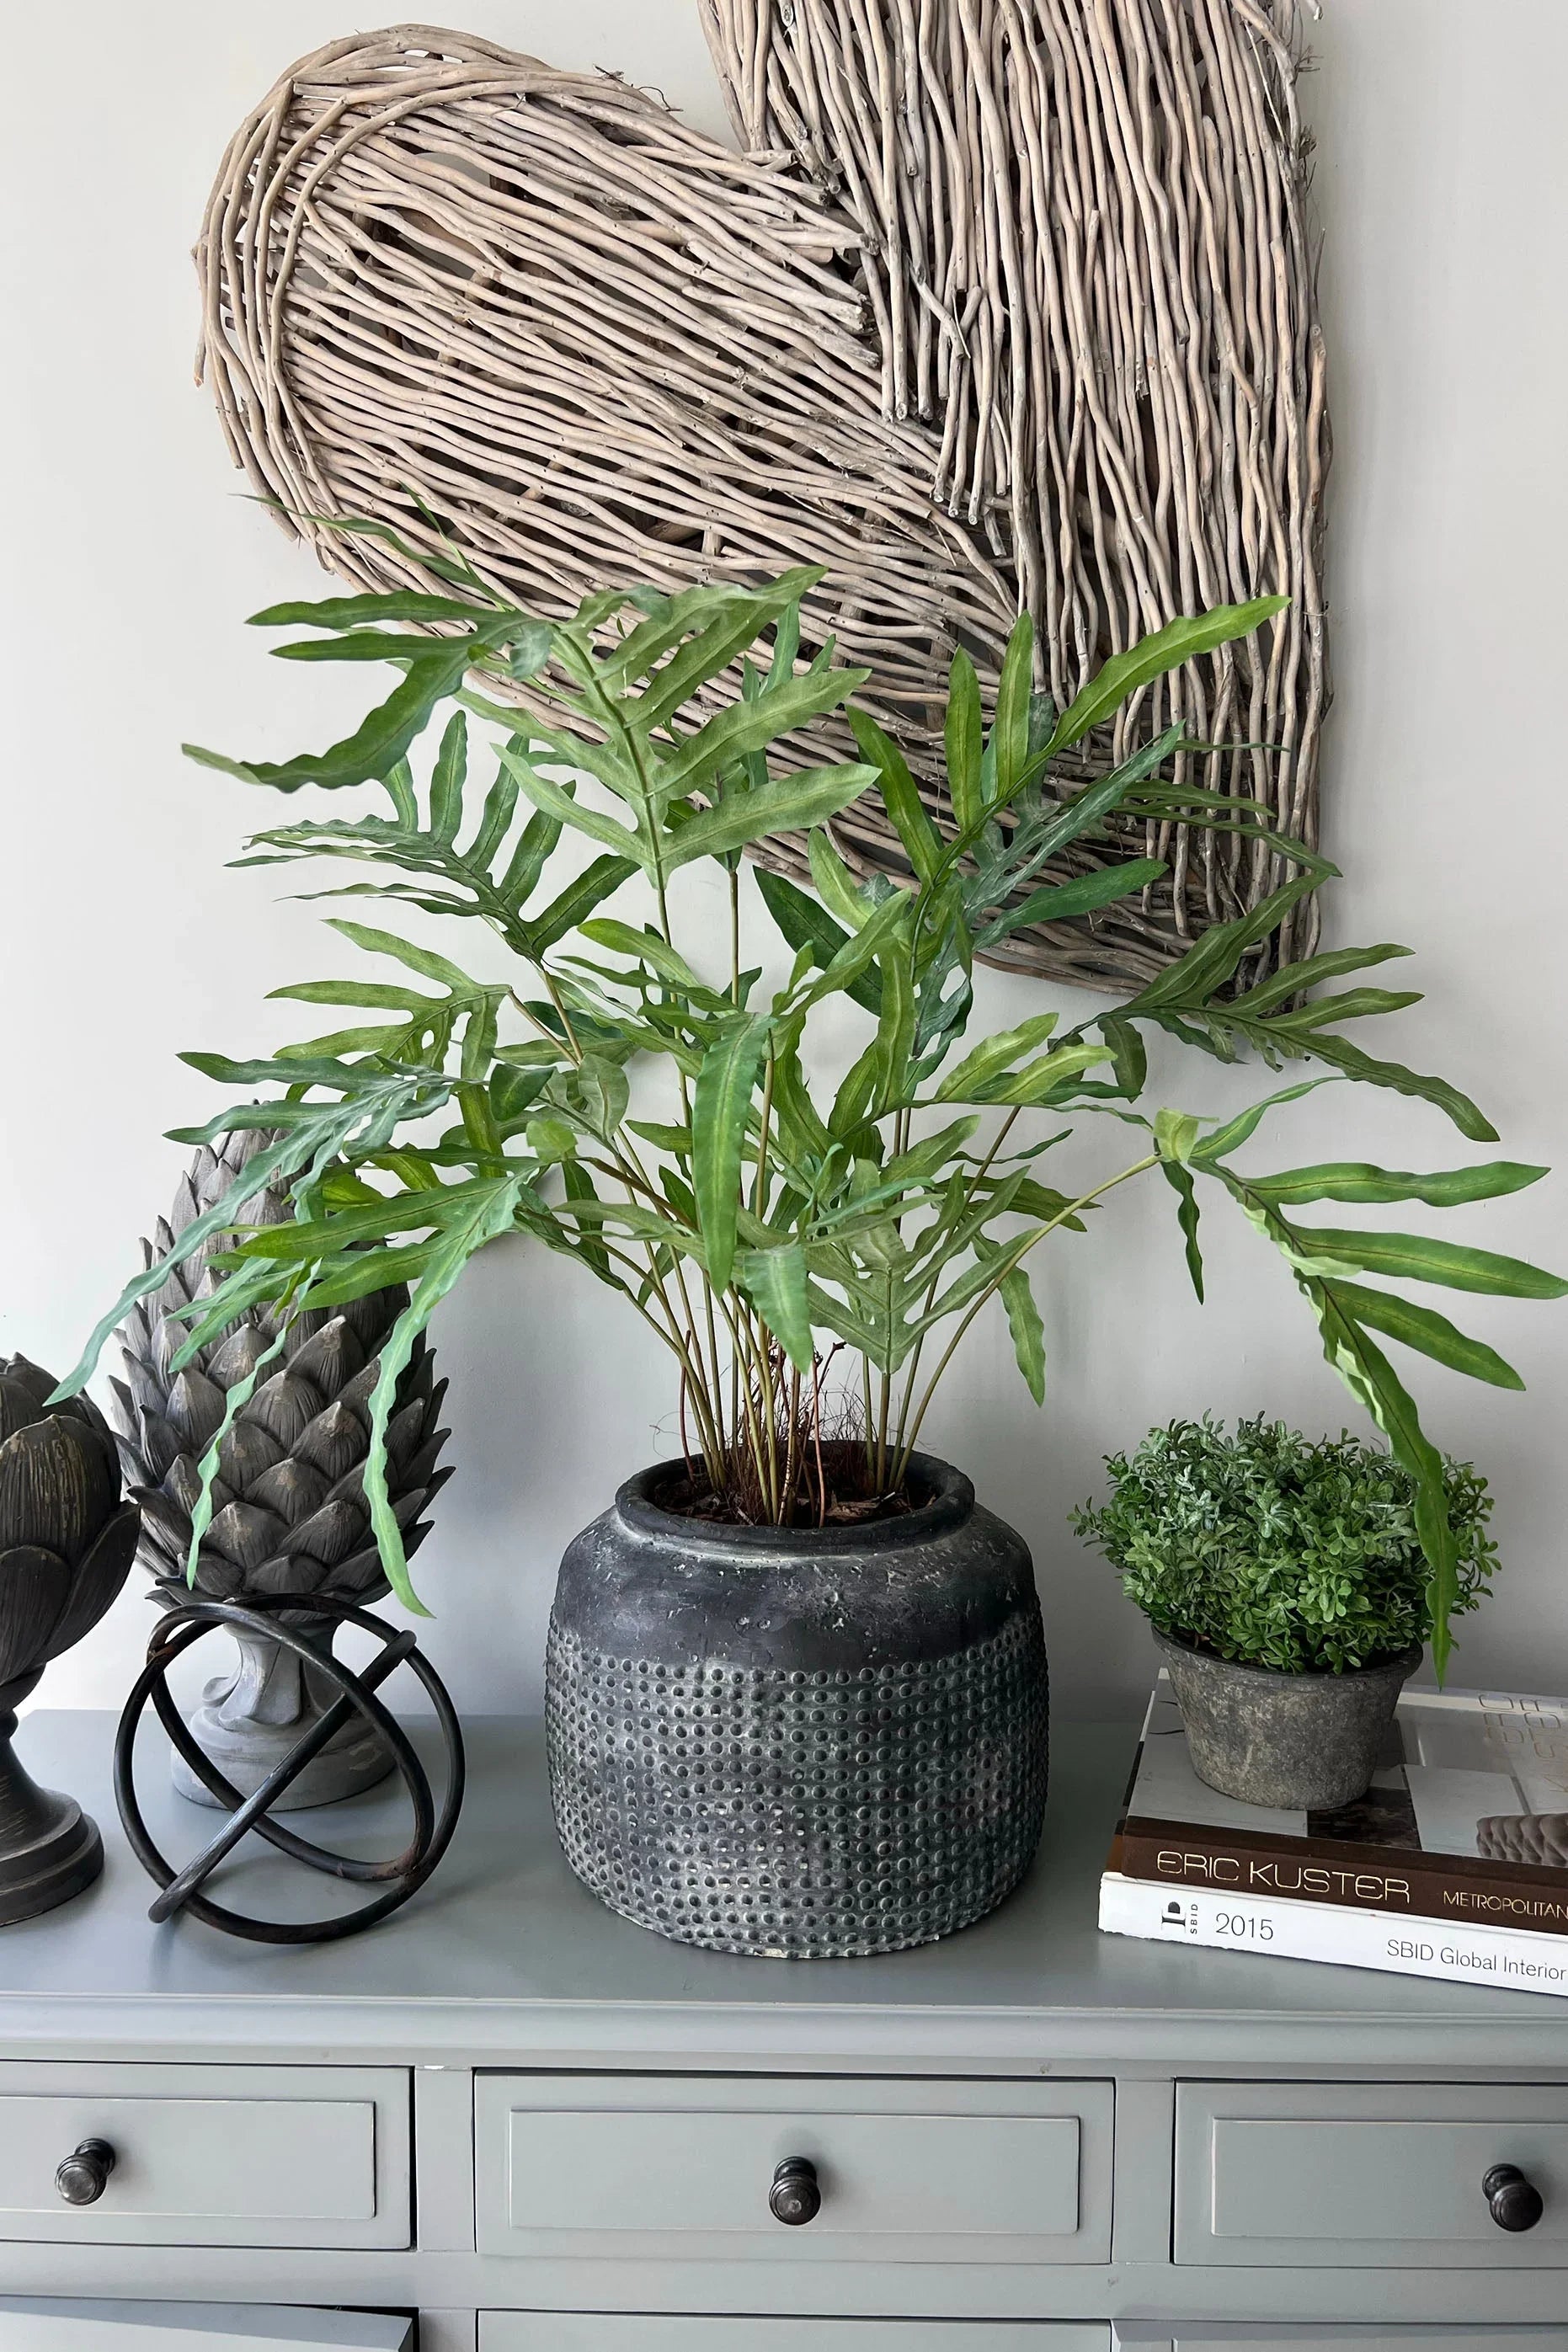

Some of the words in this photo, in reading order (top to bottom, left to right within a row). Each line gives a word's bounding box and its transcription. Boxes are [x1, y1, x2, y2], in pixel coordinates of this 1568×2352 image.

[1156, 1850, 1240, 1881] ERIC
[1249, 1861, 1411, 1904] KUSTER
[1443, 1890, 1568, 1920] METROPOLITAN
[1190, 1903, 1199, 1934] SBID
[1215, 1912, 1274, 1941] 2015
[1386, 1939, 1434, 1961] SBID
[1440, 1946, 1496, 1971] Global
[1503, 1955, 1567, 1981] Interior
